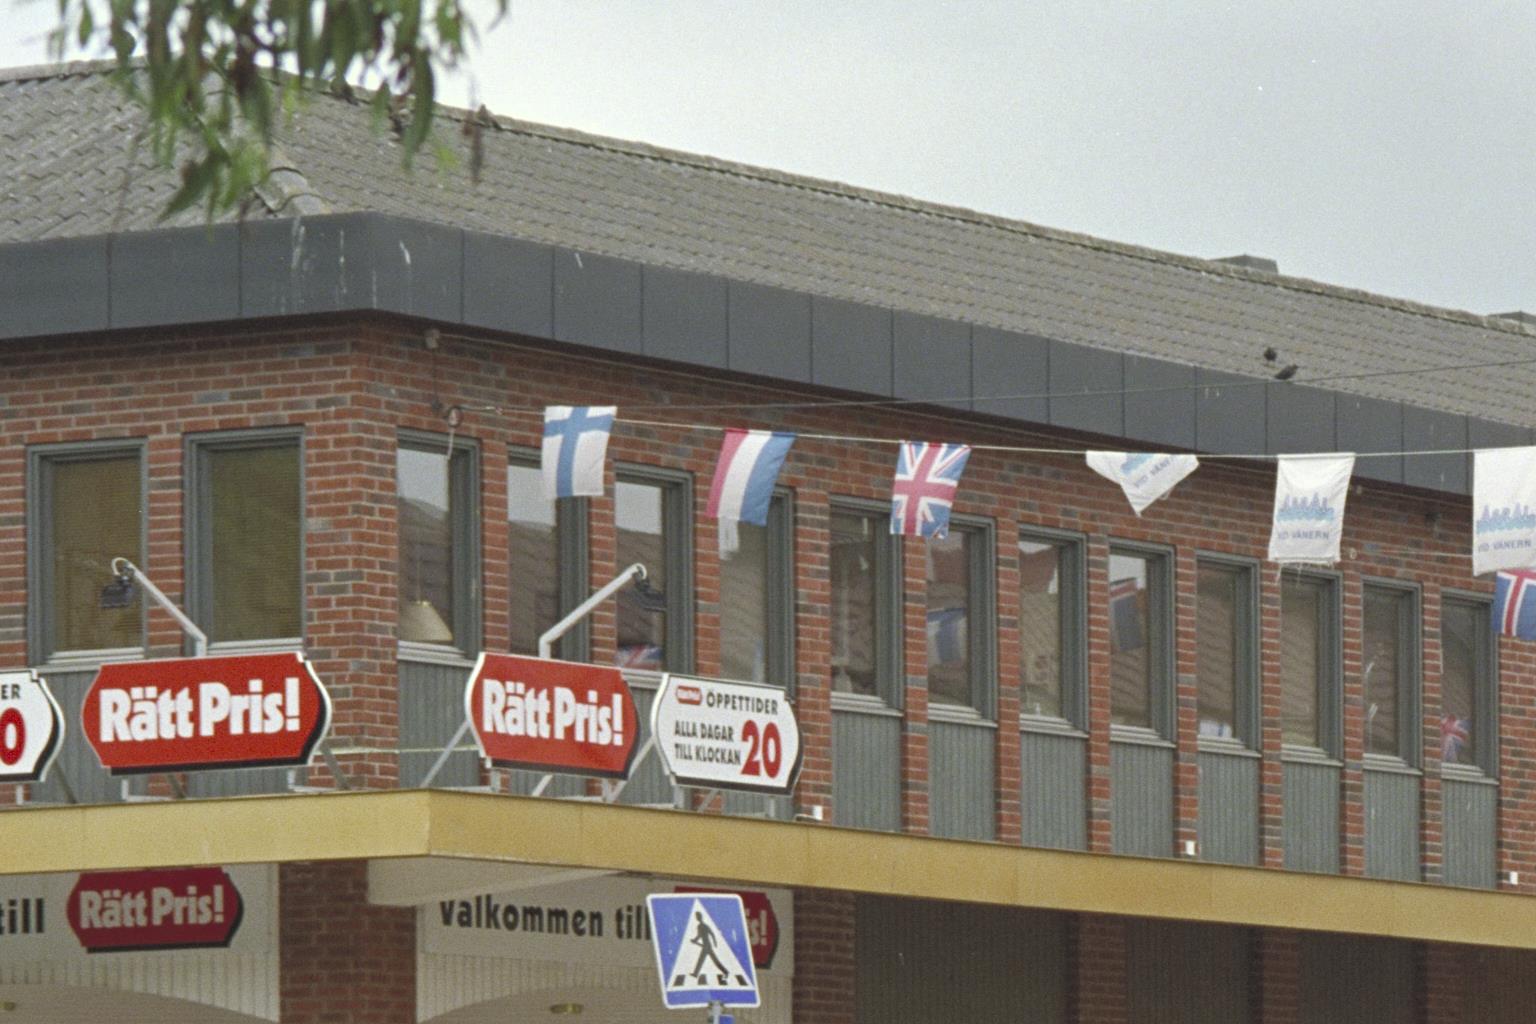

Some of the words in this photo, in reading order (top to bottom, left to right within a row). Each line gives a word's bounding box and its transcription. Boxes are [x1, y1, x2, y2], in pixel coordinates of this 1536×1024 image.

[100, 686, 195, 742] Rätt
[200, 677, 301, 737] Pris!
[483, 679, 552, 738] Rätt
[554, 686, 624, 746] Pris!
[706, 690, 779, 715] ÖPPETTIDER
[675, 720, 698, 738] ALLA
[701, 722, 734, 742] DAGAR
[740, 719, 782, 779] 20
[675, 743, 693, 760] TILL
[696, 745, 741, 765] KLOCKAN
[79, 889, 148, 929] Rätt
[151, 884, 225, 926] Pris!
